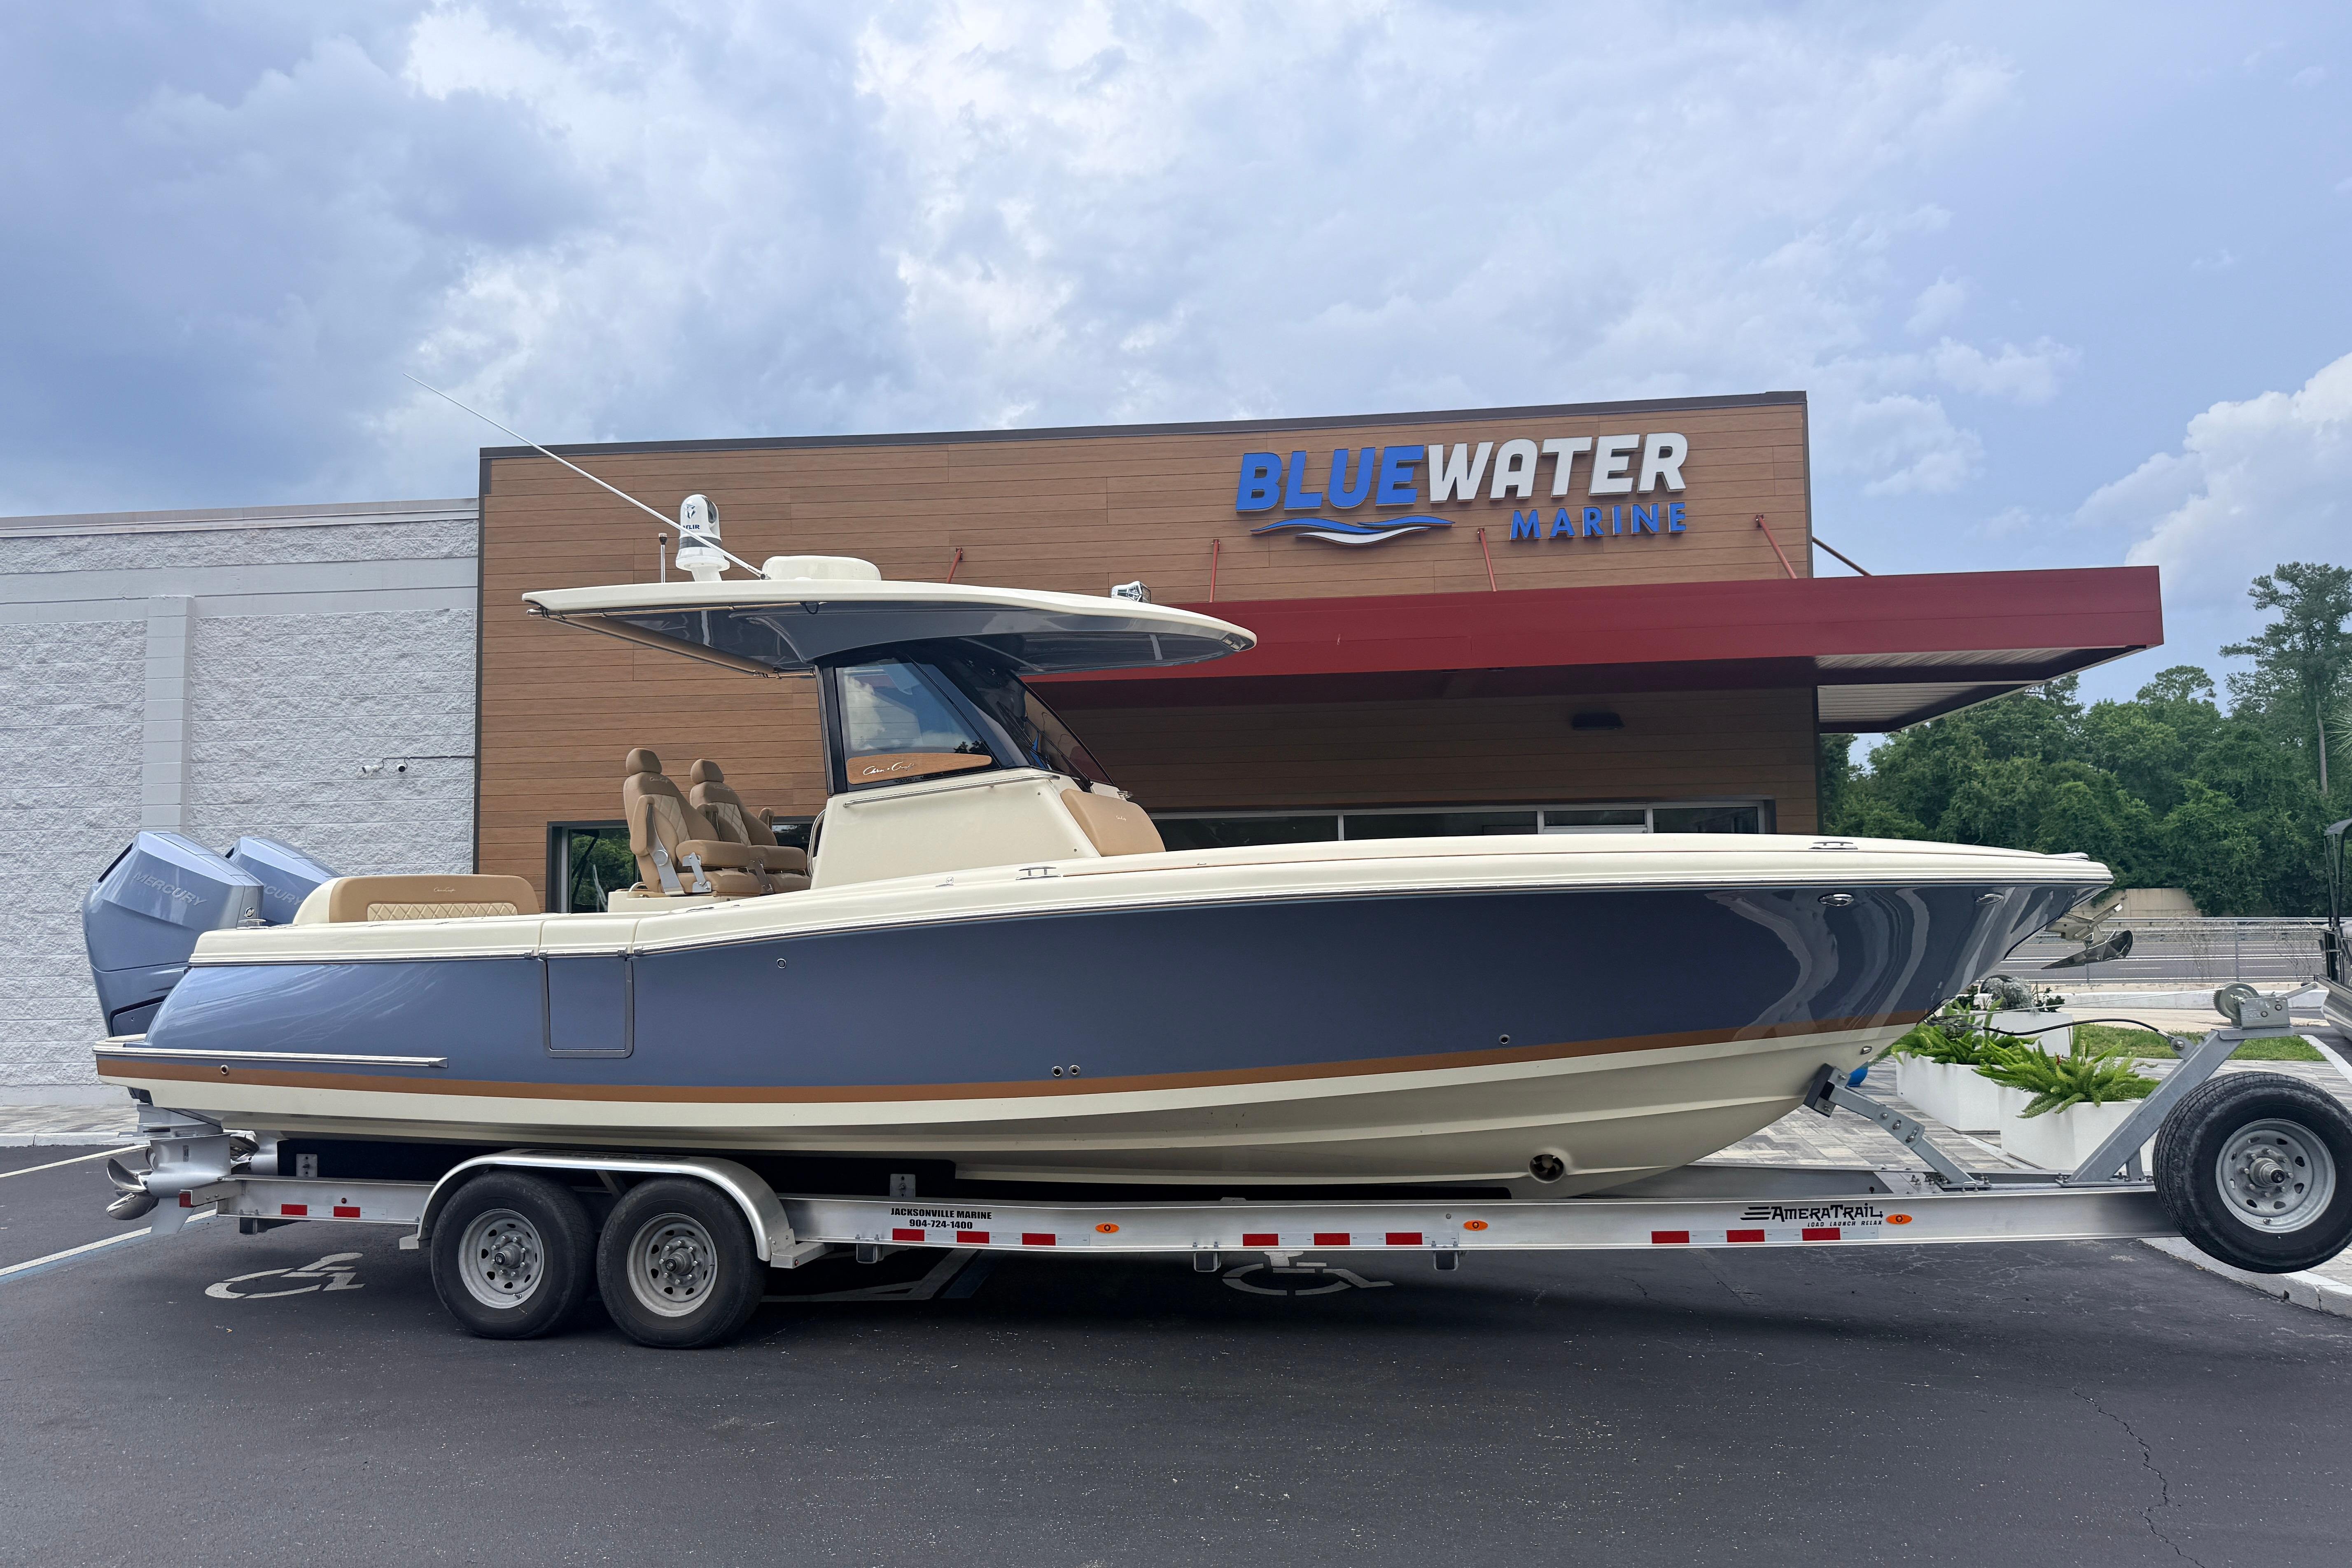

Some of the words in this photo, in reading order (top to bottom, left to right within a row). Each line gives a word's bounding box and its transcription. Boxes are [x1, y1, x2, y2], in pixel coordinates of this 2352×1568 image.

[1510, 502, 1687, 540] MARINE
[133, 872, 207, 906] MERCURY
[264, 883, 303, 905] CURY
[891, 1208, 954, 1218] JACKSONVILLE
[957, 1211, 992, 1219] MARINE
[909, 1219, 973, 1229] 904-724-1400
